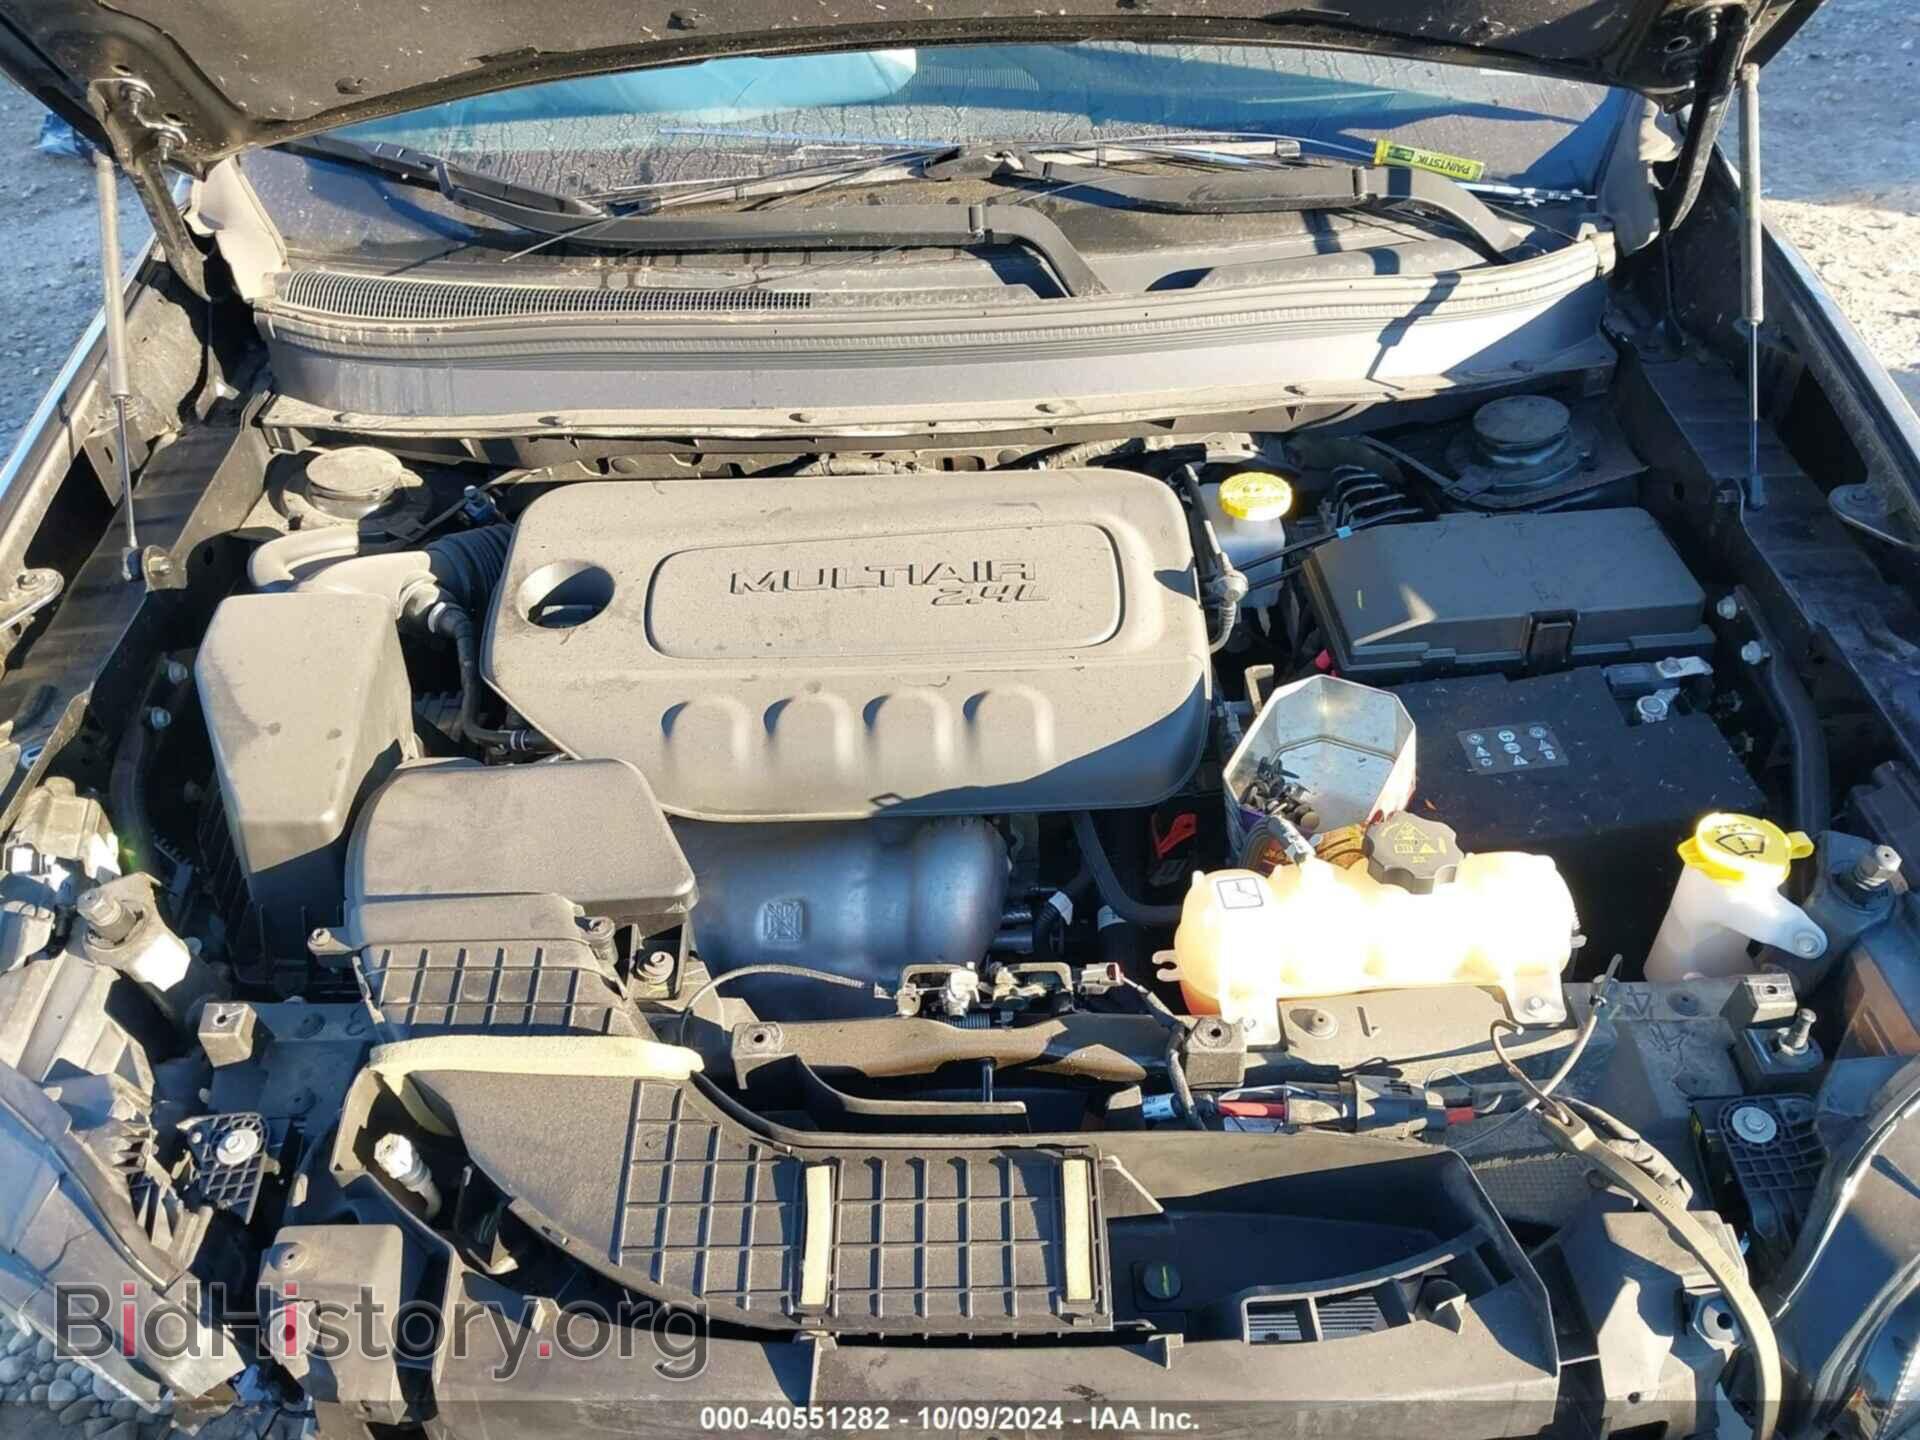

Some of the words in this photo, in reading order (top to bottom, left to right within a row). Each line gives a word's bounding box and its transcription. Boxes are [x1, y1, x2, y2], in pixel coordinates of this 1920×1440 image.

[1416, 154, 1471, 175] PAINTSTIK
[728, 559, 1037, 594] MULTIAIR
[930, 583, 1049, 606] 2.4L
